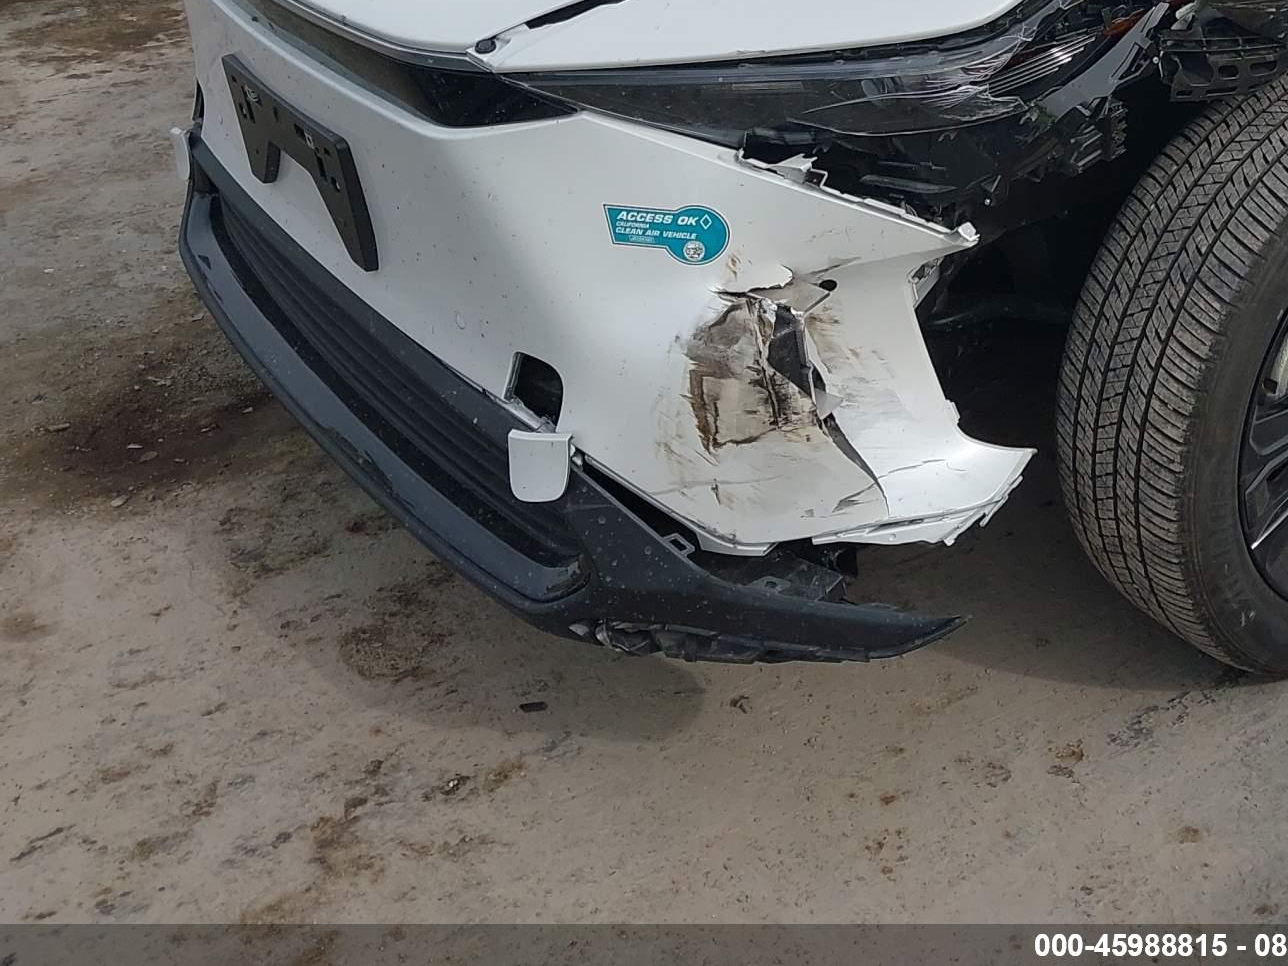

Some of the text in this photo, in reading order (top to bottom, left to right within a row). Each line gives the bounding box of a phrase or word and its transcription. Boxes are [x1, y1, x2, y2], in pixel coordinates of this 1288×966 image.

[616, 221, 650, 229] CALIFORNIA
[617, 211, 699, 226] ACCESS OK
[615, 227, 644, 235] CLEAN
[645, 229, 660, 237] AIR
[662, 230, 697, 240] VEHICLE
